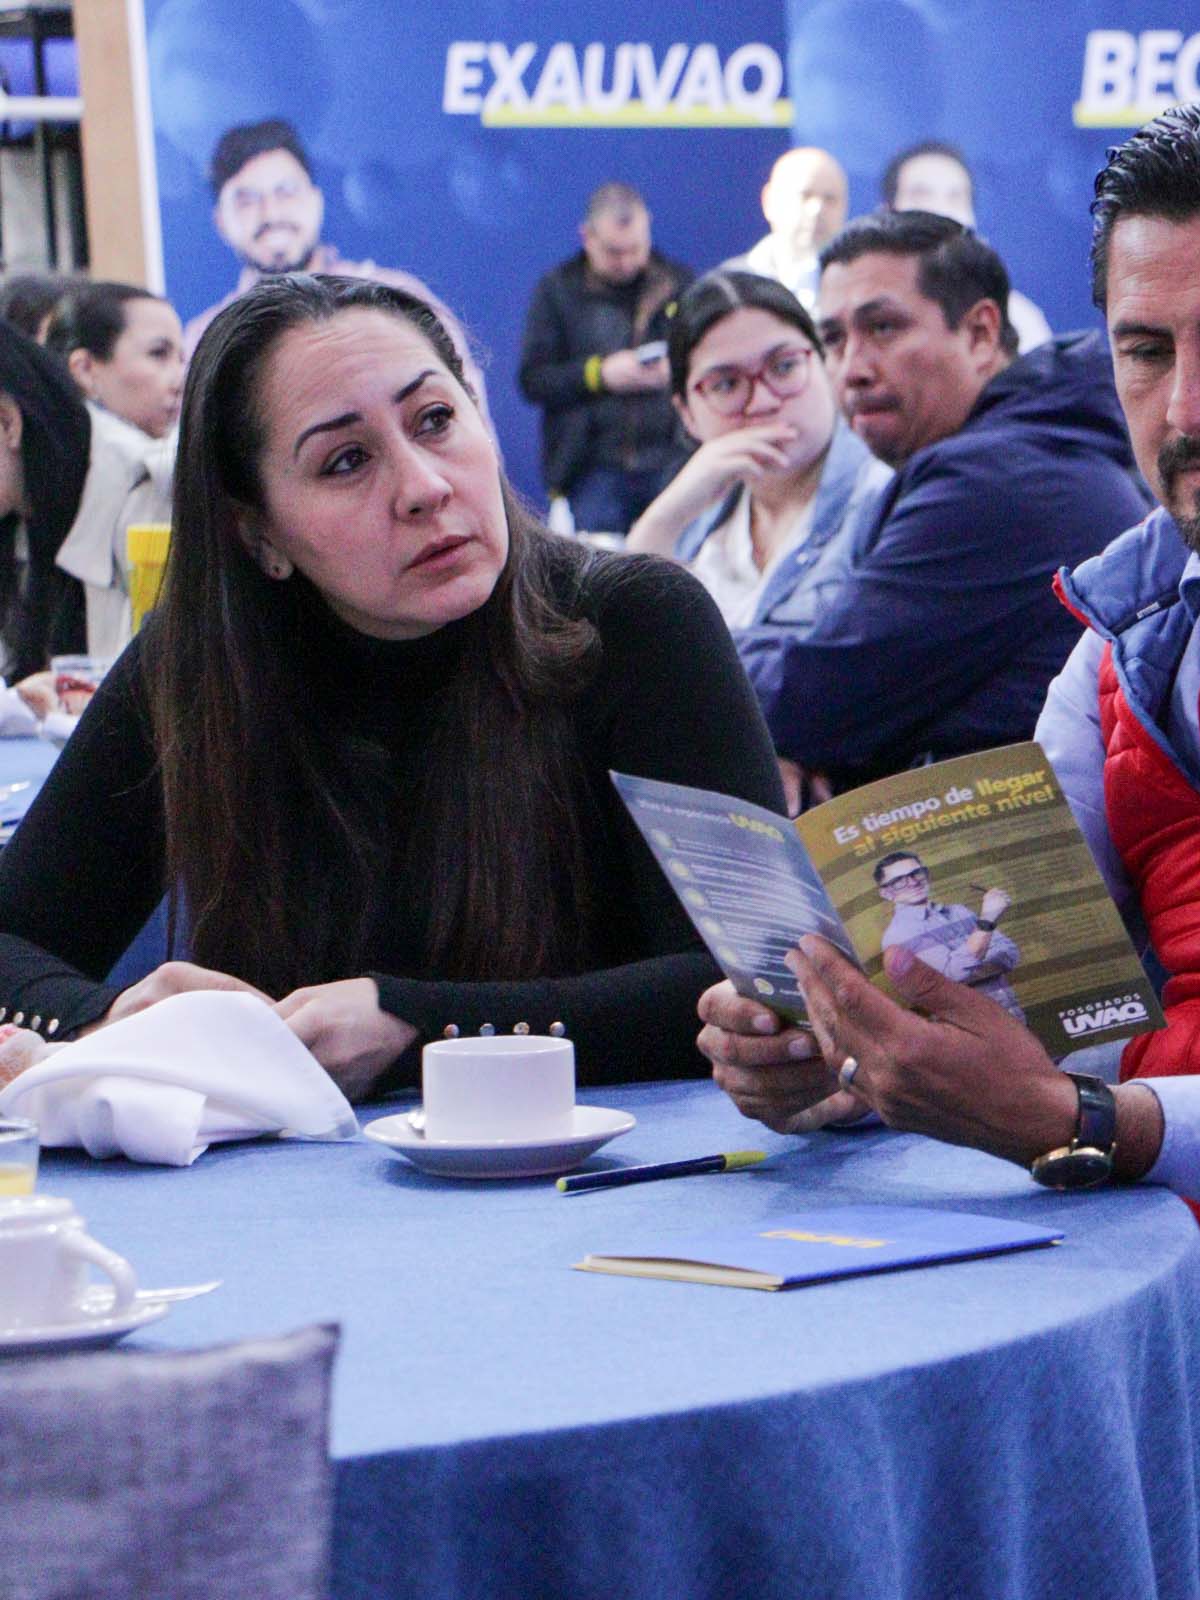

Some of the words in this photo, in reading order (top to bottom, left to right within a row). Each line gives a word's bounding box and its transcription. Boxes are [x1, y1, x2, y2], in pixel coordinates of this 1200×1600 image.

[443, 41, 783, 120] EXAUVAQ
[834, 825, 860, 845] Es
[863, 797, 941, 832] tiempo
[945, 786, 974, 806] de
[976, 770, 1046, 797] llegar
[880, 803, 992, 845] siguiente
[996, 783, 1056, 812] nivel
[1059, 993, 1140, 1018] POSGRADOS
[1062, 1001, 1147, 1034] UVAQ
